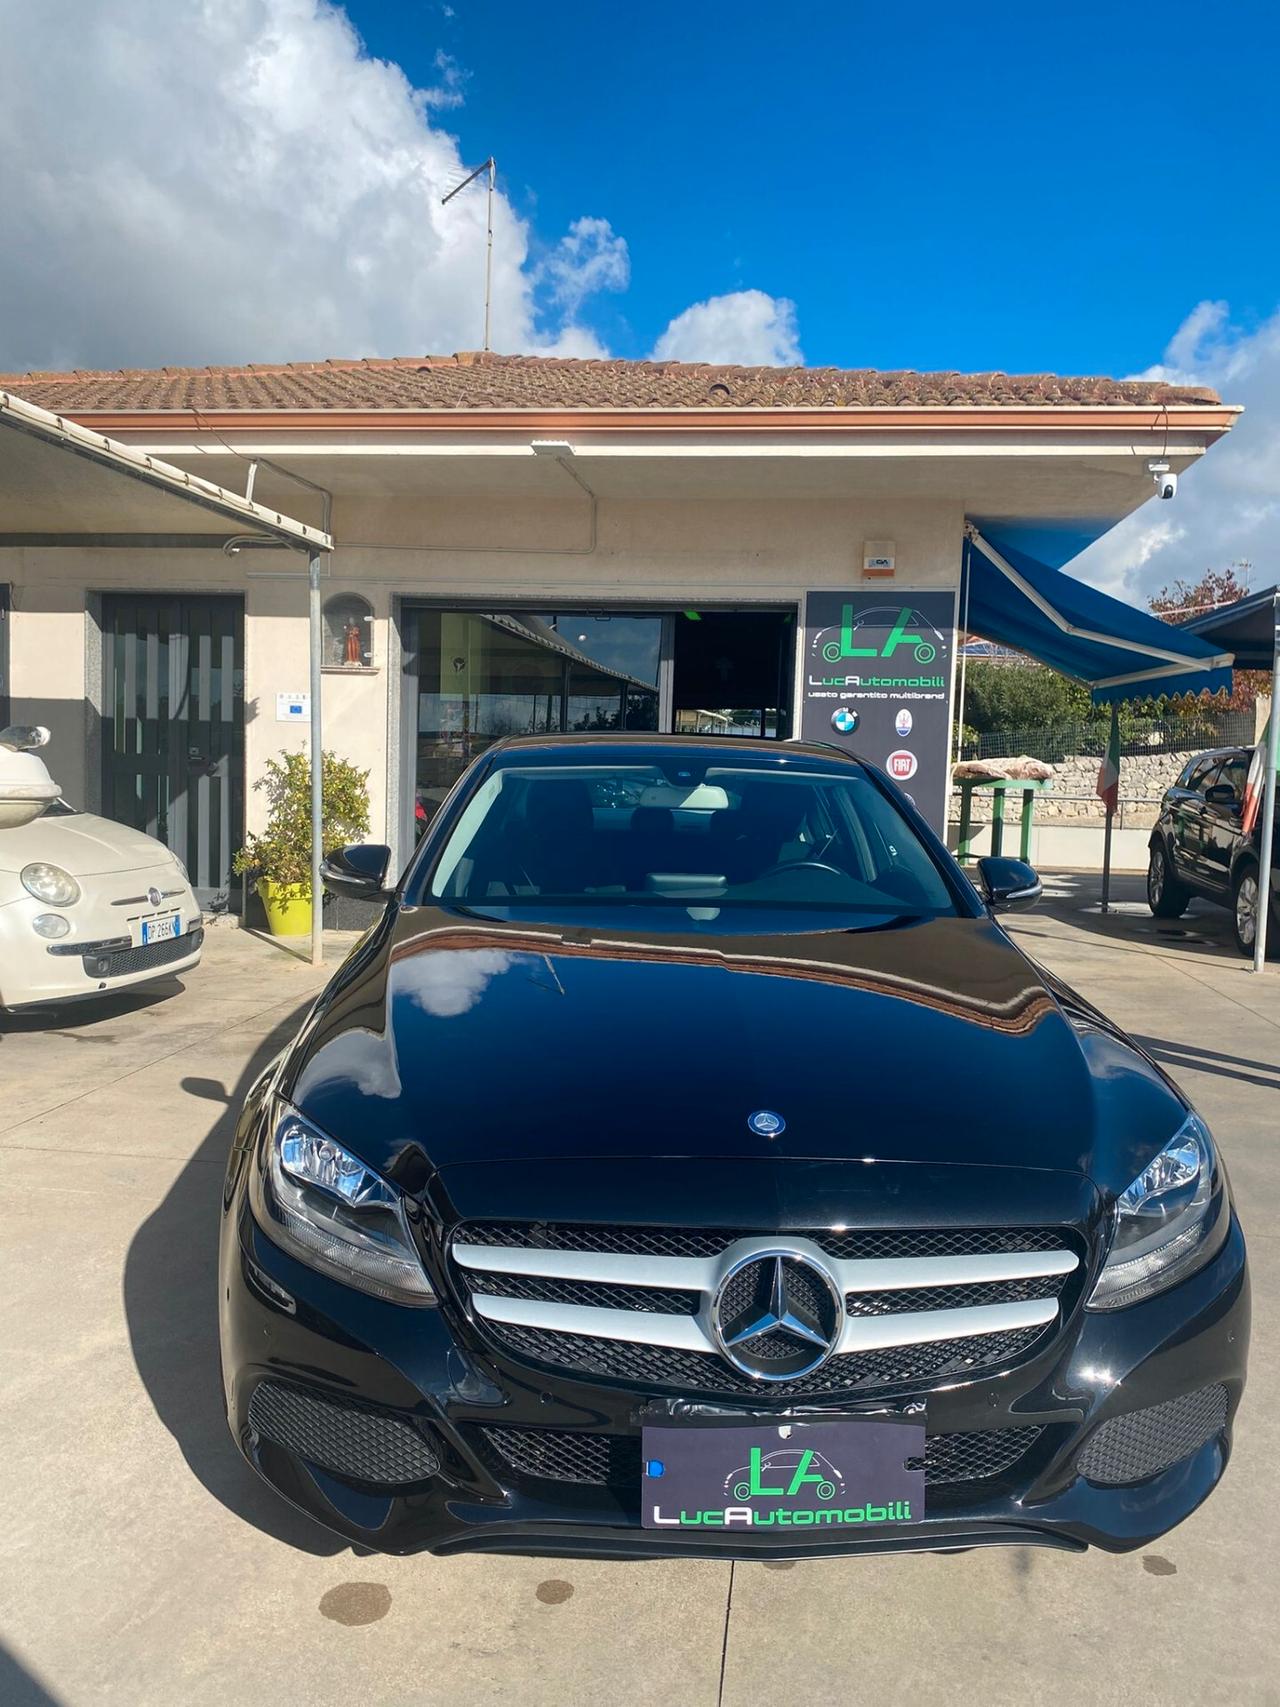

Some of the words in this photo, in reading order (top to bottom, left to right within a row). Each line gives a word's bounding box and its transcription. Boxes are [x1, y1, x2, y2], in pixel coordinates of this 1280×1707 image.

[808, 675, 945, 687] LucAutomobili
[808, 691, 838, 699] usato
[840, 691, 888, 700] garantito
[889, 692, 945, 700] multibrand
[893, 758, 911, 772] FIAT
[750, 1446, 824, 1496] LA
[653, 1500, 912, 1526] LucAutomobili
